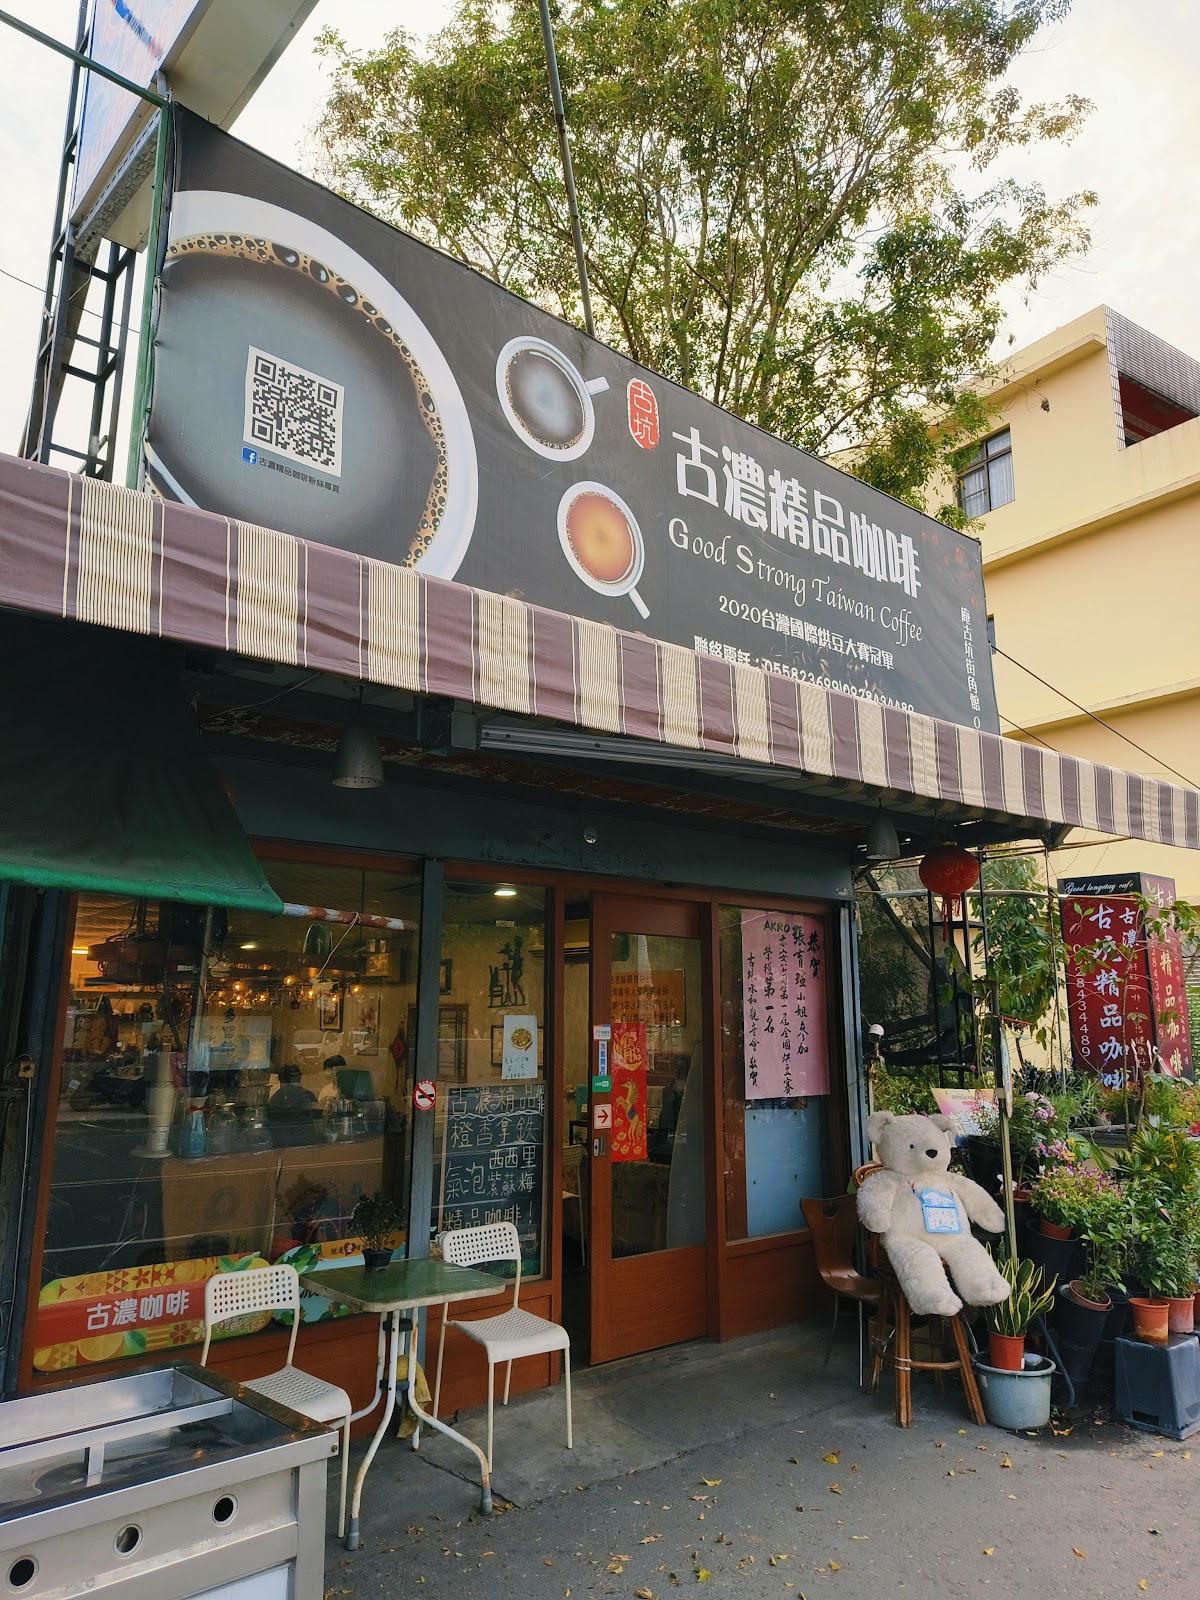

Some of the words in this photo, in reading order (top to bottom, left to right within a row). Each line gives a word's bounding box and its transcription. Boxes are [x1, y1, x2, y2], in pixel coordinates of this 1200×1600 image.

[631, 381, 656, 445] 古坑
[671, 425, 923, 600] 古濃精品咖啡
[668, 517, 732, 567] Good
[736, 544, 807, 607] Strong
[811, 575, 877, 624] Taiwan
[879, 606, 924, 647] Coffee
[718, 595, 895, 671] 2020台灣國際烘豆大賽冠軍
[763, 919, 790, 934] AKRO
[445, 1160, 486, 1202] 氣泡
[489, 1145, 537, 1170] 西西里
[86, 1290, 191, 1331] 古濃咖啡
